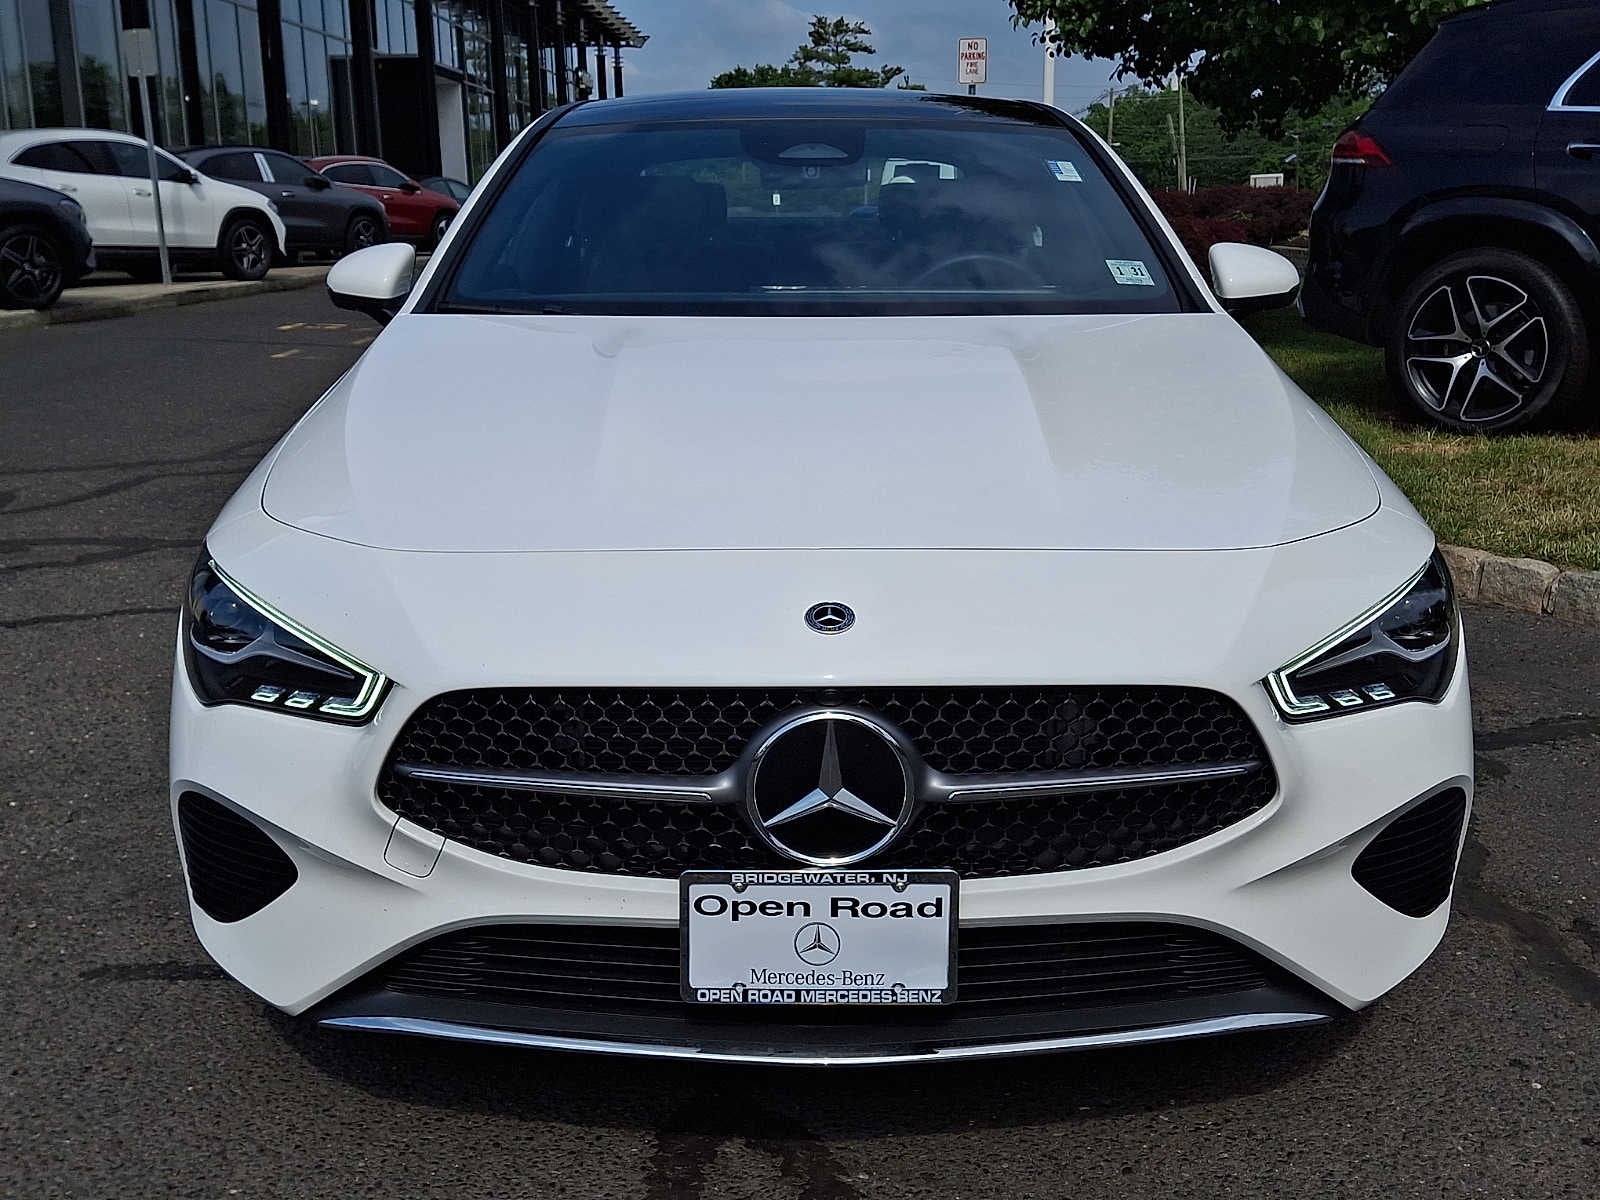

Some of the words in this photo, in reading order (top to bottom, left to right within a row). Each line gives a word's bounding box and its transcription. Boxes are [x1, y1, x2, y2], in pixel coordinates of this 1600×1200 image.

[967, 41, 979, 50] NO
[960, 52, 985, 60] PARKING
[1116, 266, 1125, 276] 1
[1130, 266, 1145, 276] 31
[731, 873, 875, 884] BRIDGEWATER,
[882, 873, 908, 884] NJ
[693, 894, 811, 922] Open
[830, 896, 943, 919] Road
[750, 968, 885, 986] Mercedes-Benz
[697, 989, 743, 1002] OPEN
[748, 989, 795, 1003] ROAD
